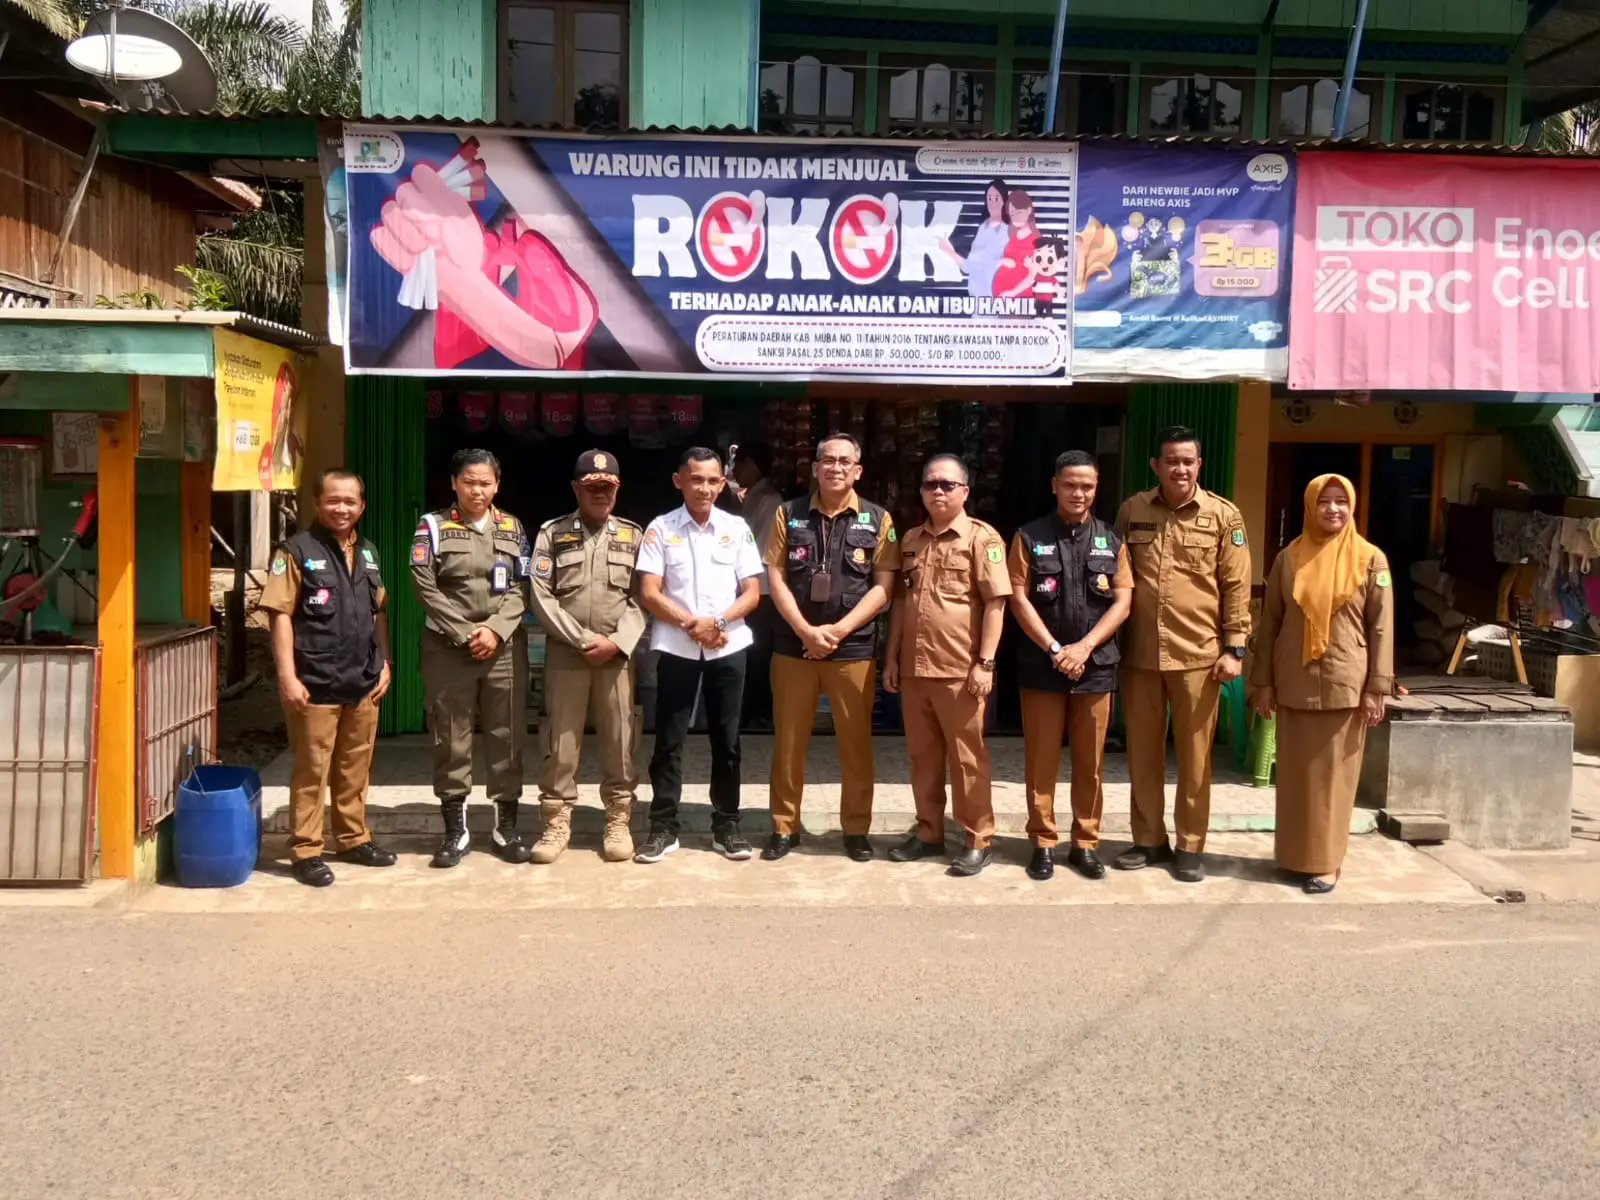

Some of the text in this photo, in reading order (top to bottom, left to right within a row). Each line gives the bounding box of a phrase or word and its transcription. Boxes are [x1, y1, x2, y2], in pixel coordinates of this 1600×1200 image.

[568, 152, 909, 182] WARUNG INI TIDAK MENJUAL
[1252, 163, 1283, 174] AXIS
[1122, 185, 1147, 195] DARI
[1149, 186, 1190, 196] NEWBIE
[1191, 187, 1215, 197] JADI
[1216, 188, 1240, 197] MVP
[1122, 198, 1191, 208] BARENG AXIS
[631, 190, 964, 285] ROKOK
[1336, 210, 1464, 248] TOKO
[1216, 277, 1255, 286] Rp 15.000
[1365, 268, 1472, 314] SRC
[1492, 265, 1591, 309] Cell
[669, 291, 1037, 316] TERHADAP ANAK-ANAK DAN IBU HAMIL
[712, 331, 758, 342] PERATURAN
[760, 332, 792, 342] DAERAH
[815, 333, 837, 343] MUBA
[856, 333, 862, 343] 11
[865, 334, 890, 344] TAHUN
[892, 334, 911, 344] 2016
[915, 334, 951, 345] TENTANG
[953, 335, 992, 345] KAWASAN
[995, 335, 1020, 345] TANPA
[1022, 336, 1050, 346] ROKOK
[757, 347, 785, 358] SANKSI
[786, 348, 811, 358] PASAL
[813, 348, 824, 358] 25
[826, 348, 851, 358] DENDA
[854, 349, 873, 359] DARI
[928, 349, 942, 359] S/D
